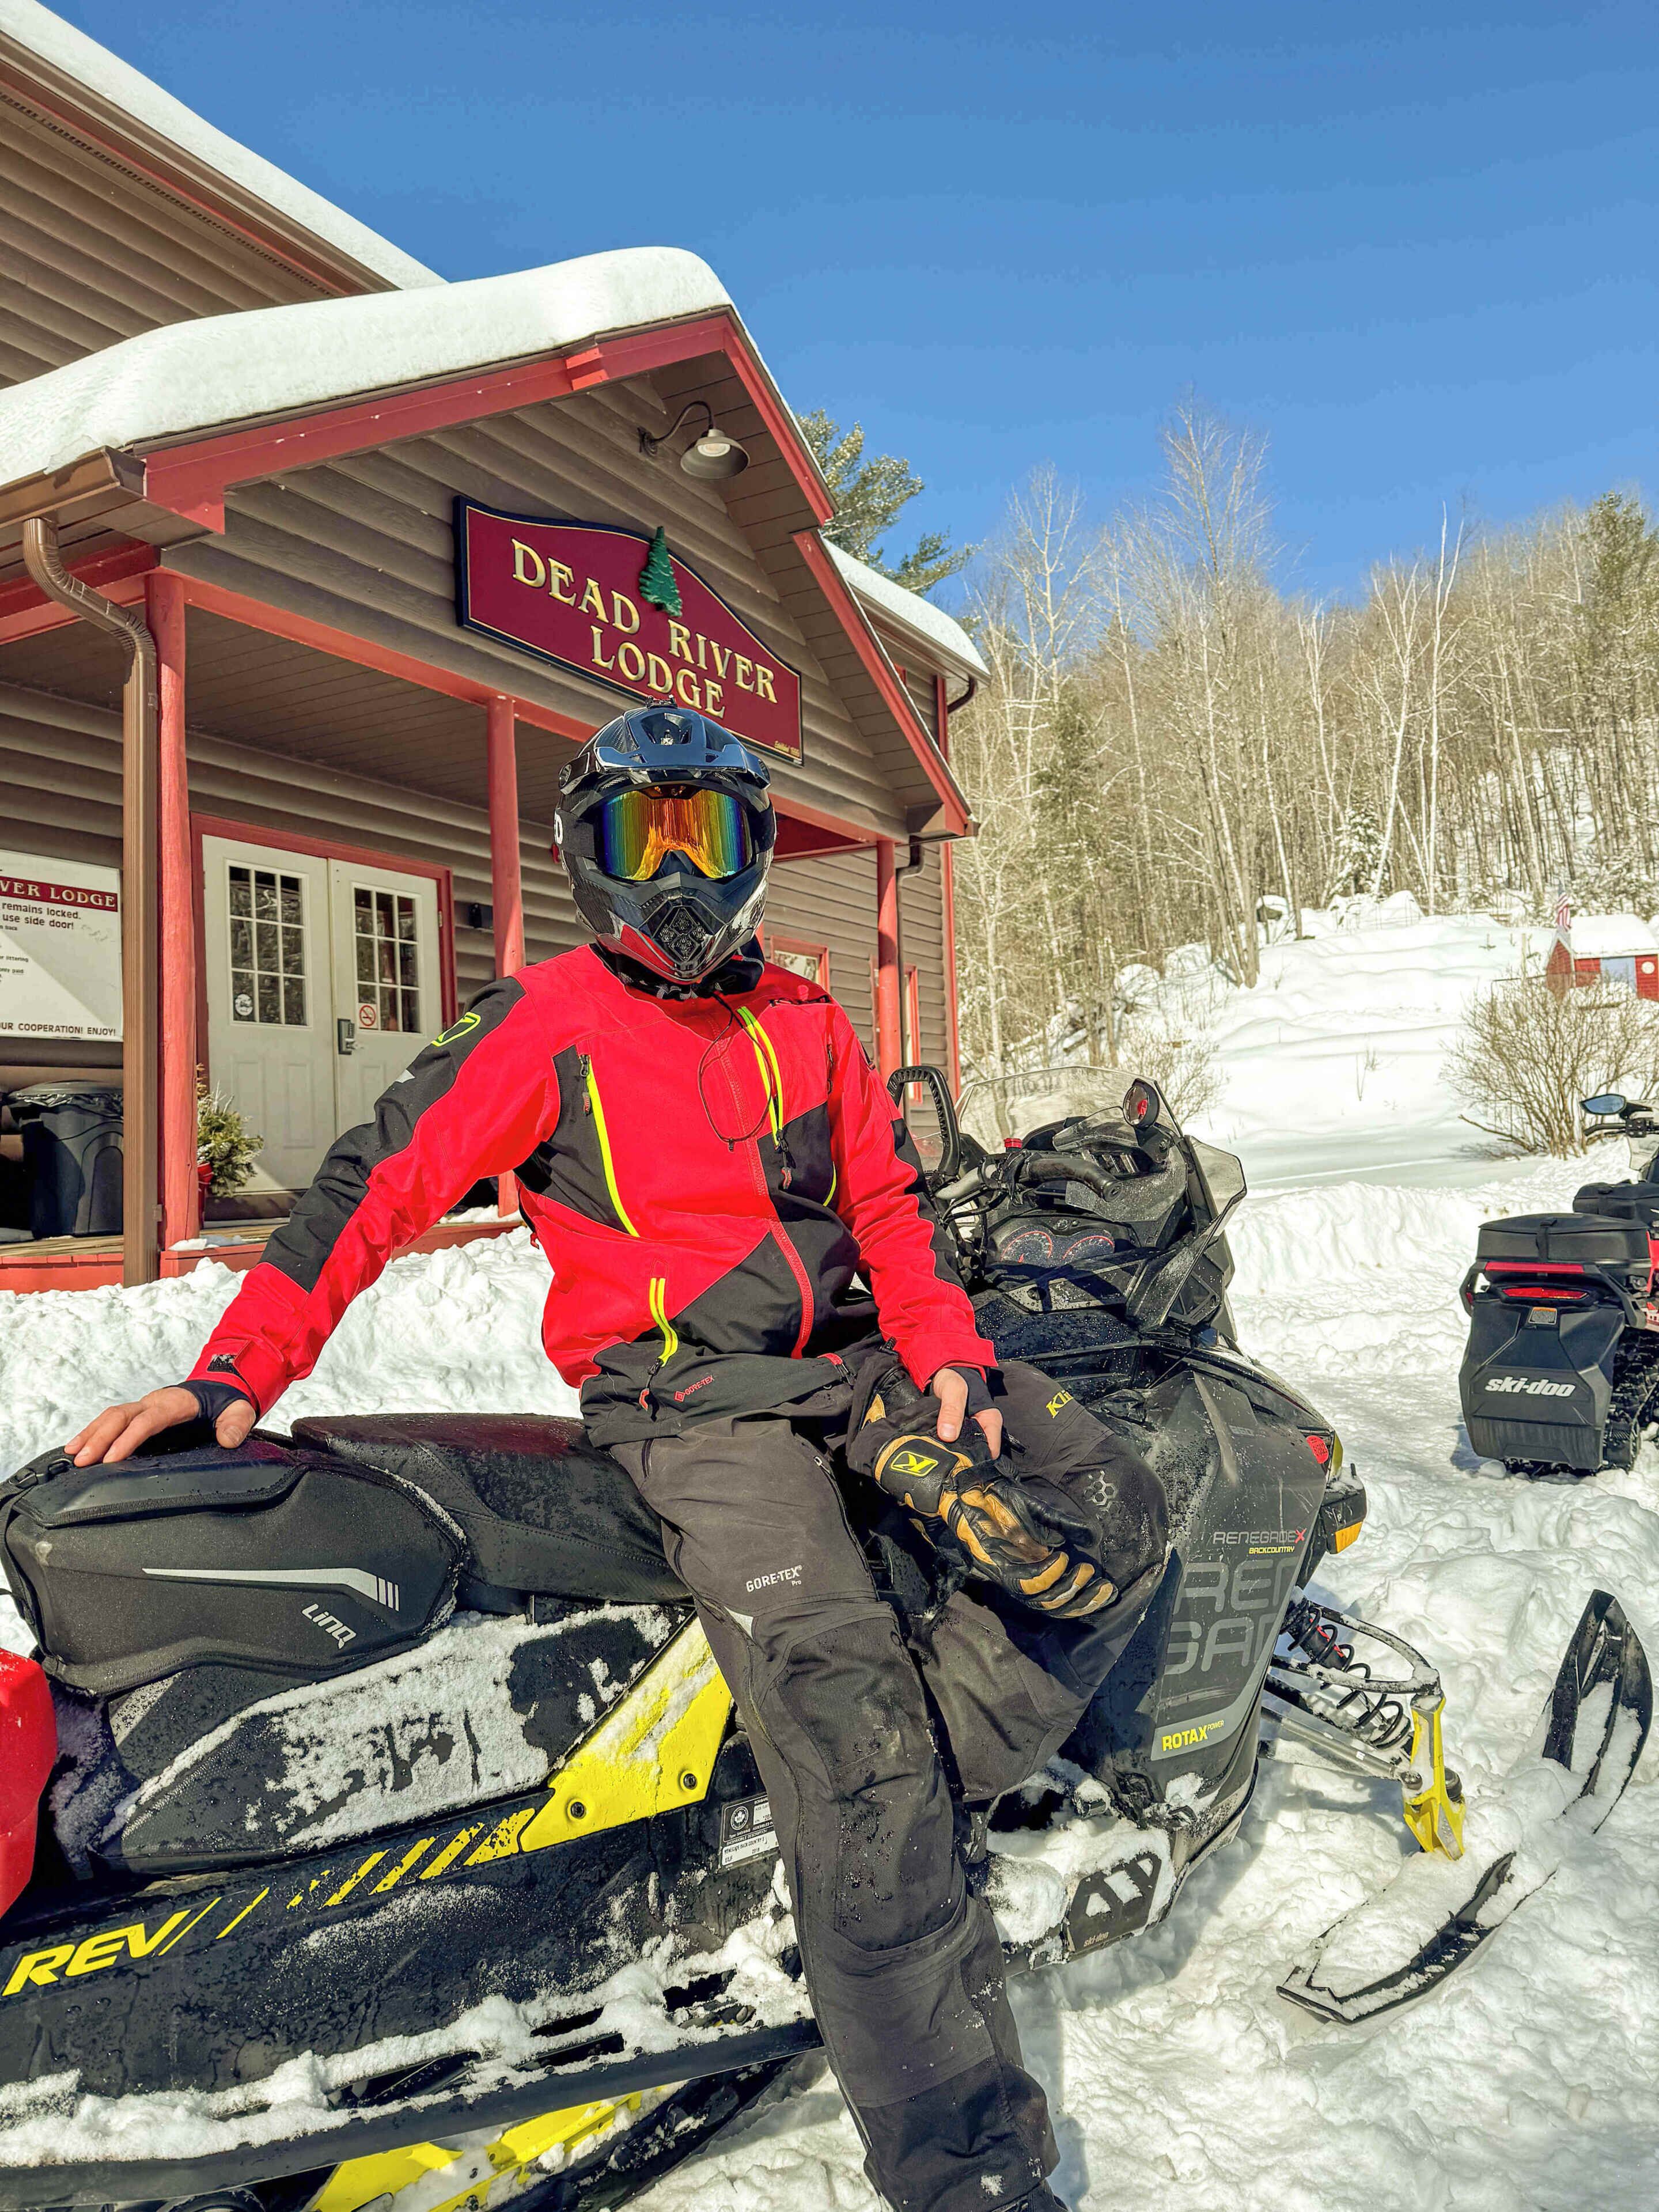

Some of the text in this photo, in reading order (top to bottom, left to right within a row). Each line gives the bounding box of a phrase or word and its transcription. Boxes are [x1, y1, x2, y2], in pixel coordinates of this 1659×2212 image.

[510, 538, 778, 703] DEAD RIVER
[590, 625, 725, 719] LODGE
[50, 887, 115, 907] LODGE
[2, 902, 81, 919] remains locked.
[3, 914, 74, 929] use side door!
[0, 1022, 116, 1036] UR COOPERATION! ENJOY!
[1485, 1376, 1575, 1397] ski-doo
[1162, 1719, 1224, 1751] ROTAX POWER
[2, 1909, 191, 1997] REV
